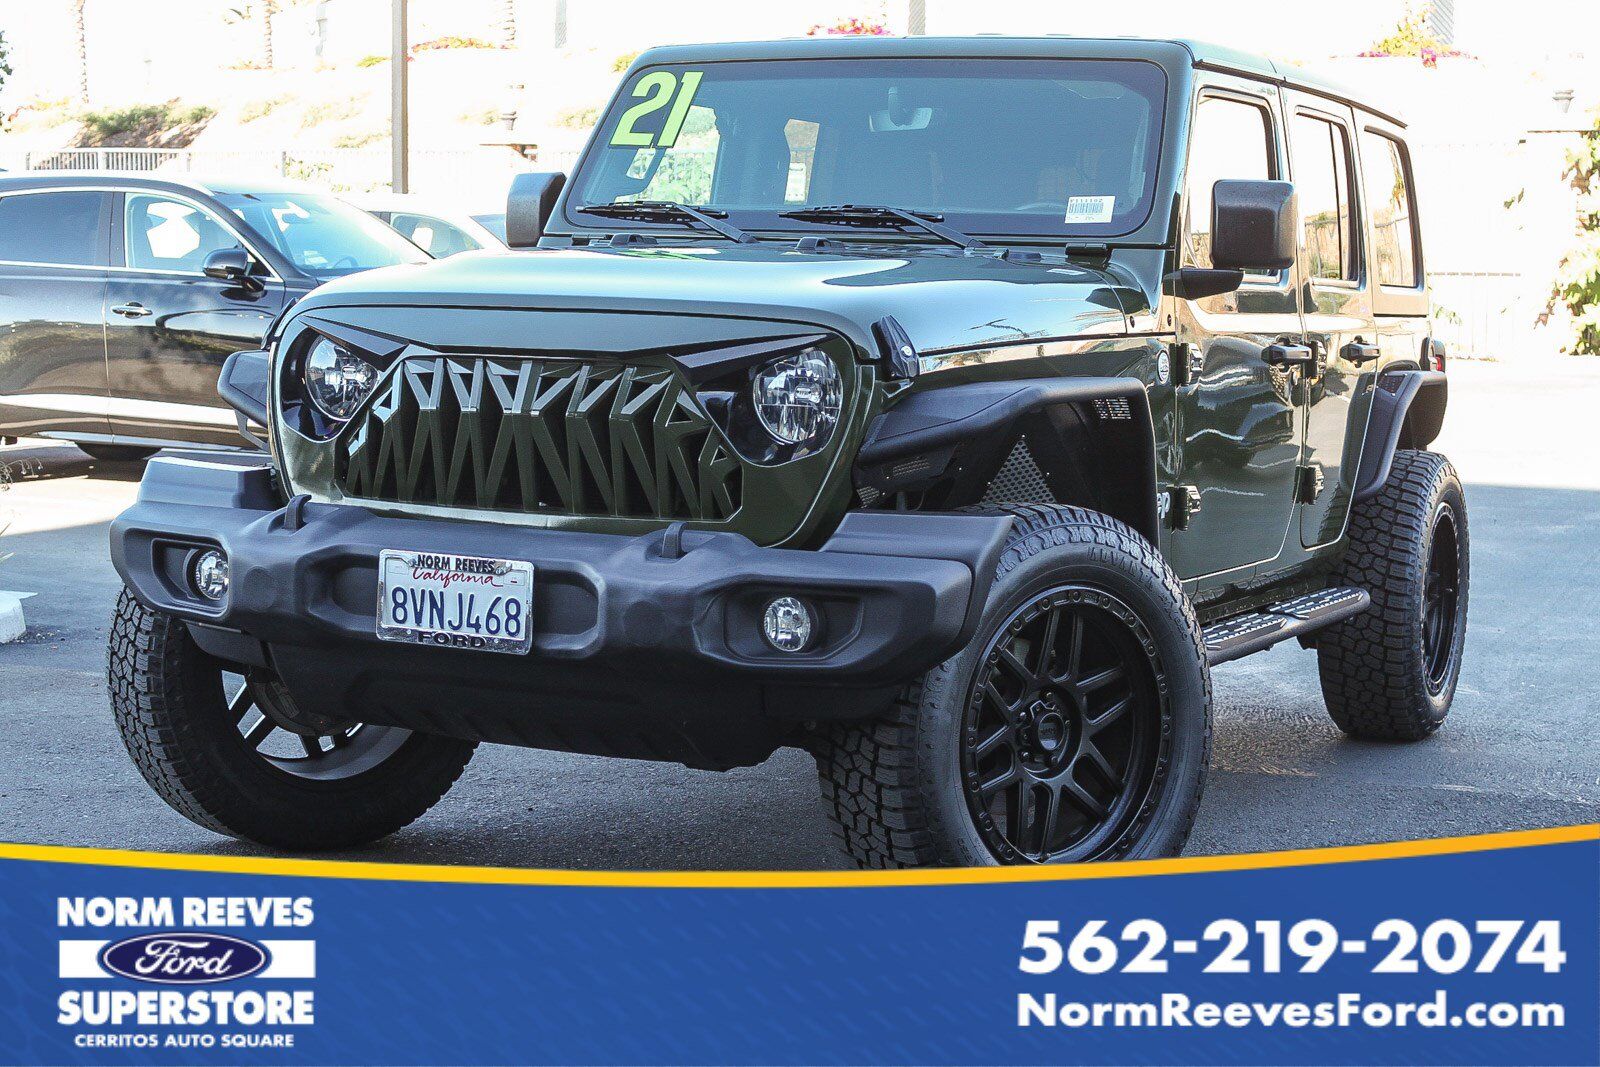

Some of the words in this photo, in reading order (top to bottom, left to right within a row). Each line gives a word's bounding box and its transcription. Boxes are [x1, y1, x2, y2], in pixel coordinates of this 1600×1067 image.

[608, 70, 704, 148] 21
[417, 554, 451, 570] NORM
[455, 557, 496, 573] REEVES
[412, 567, 504, 588] California
[391, 586, 522, 638] 8VNJ468
[417, 631, 487, 648] FORD
